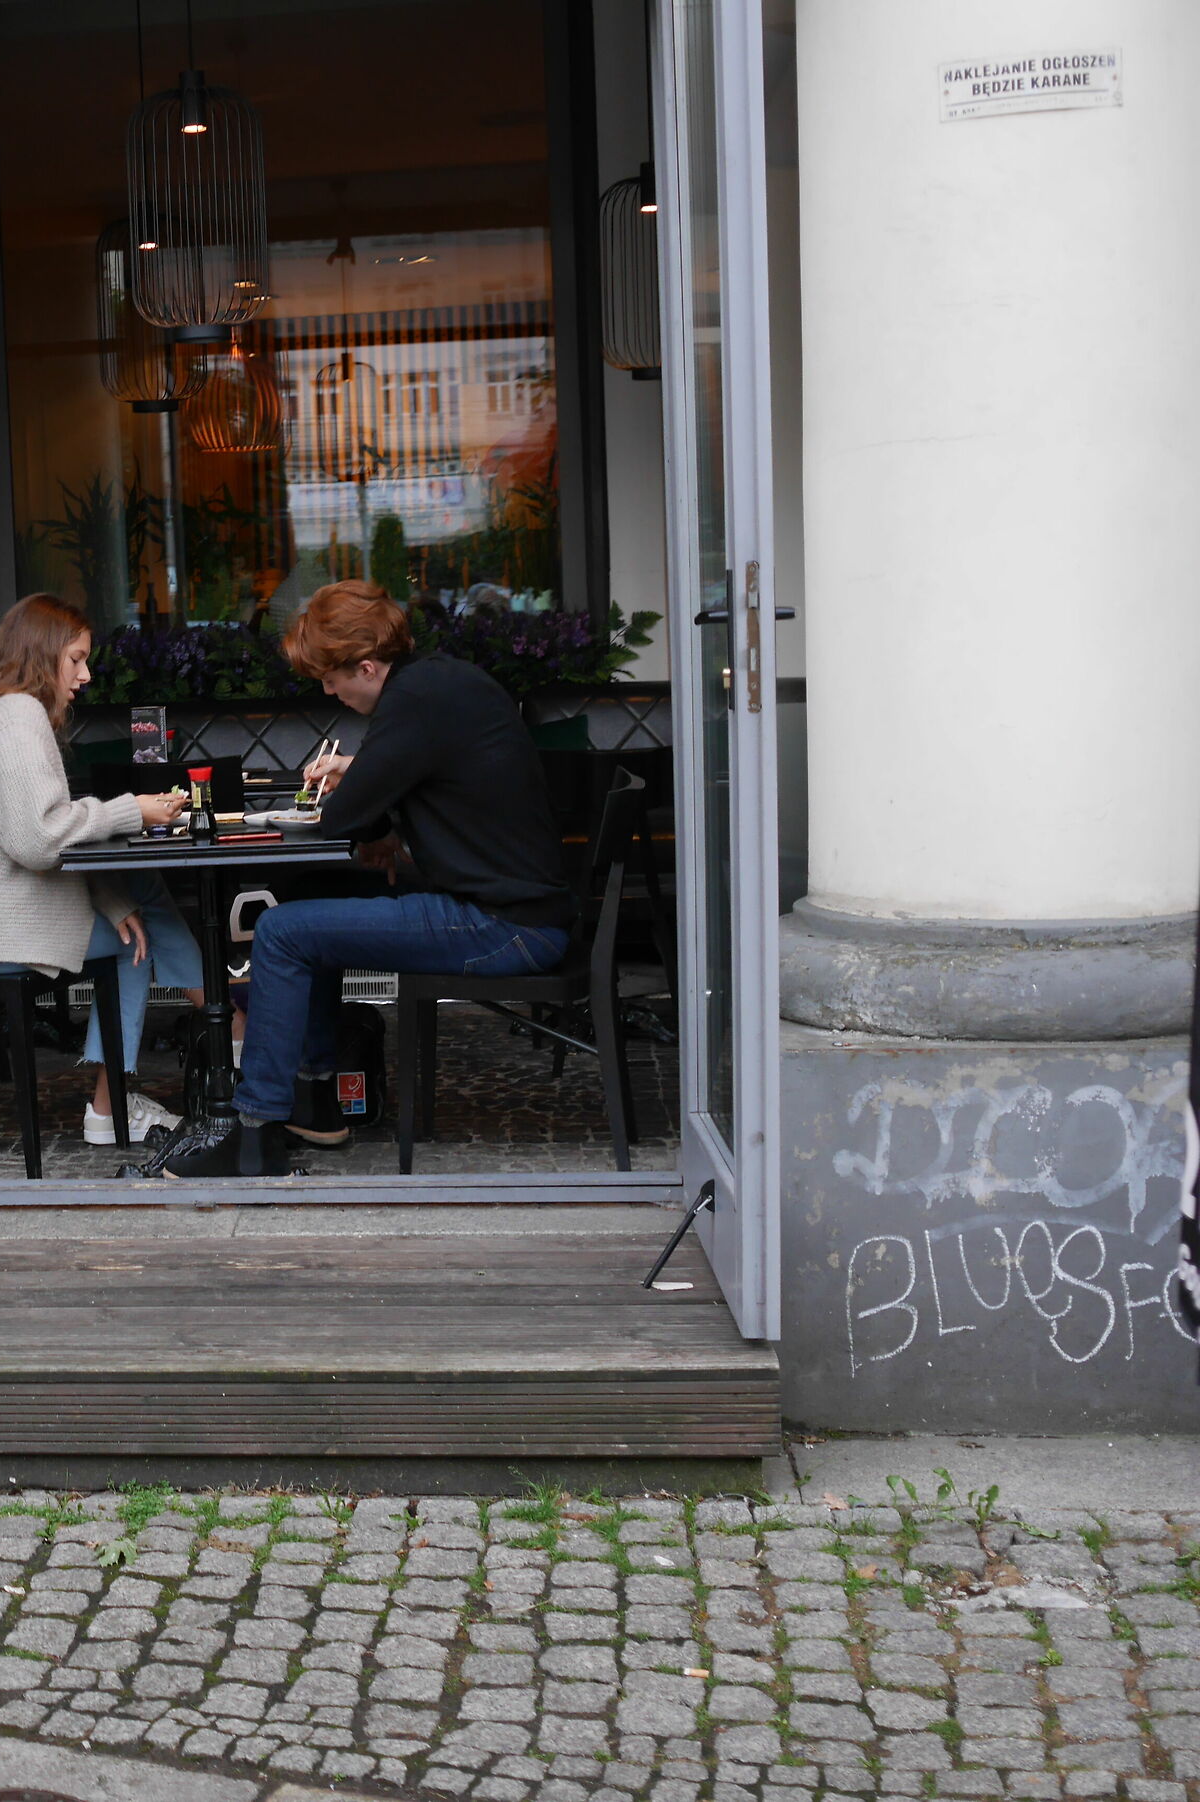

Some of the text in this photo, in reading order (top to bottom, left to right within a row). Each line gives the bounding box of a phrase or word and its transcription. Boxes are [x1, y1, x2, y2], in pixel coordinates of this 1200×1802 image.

[944, 60, 1036, 83] NAKLEJANIE
[972, 73, 1090, 96] BĘDZIE KARANE
